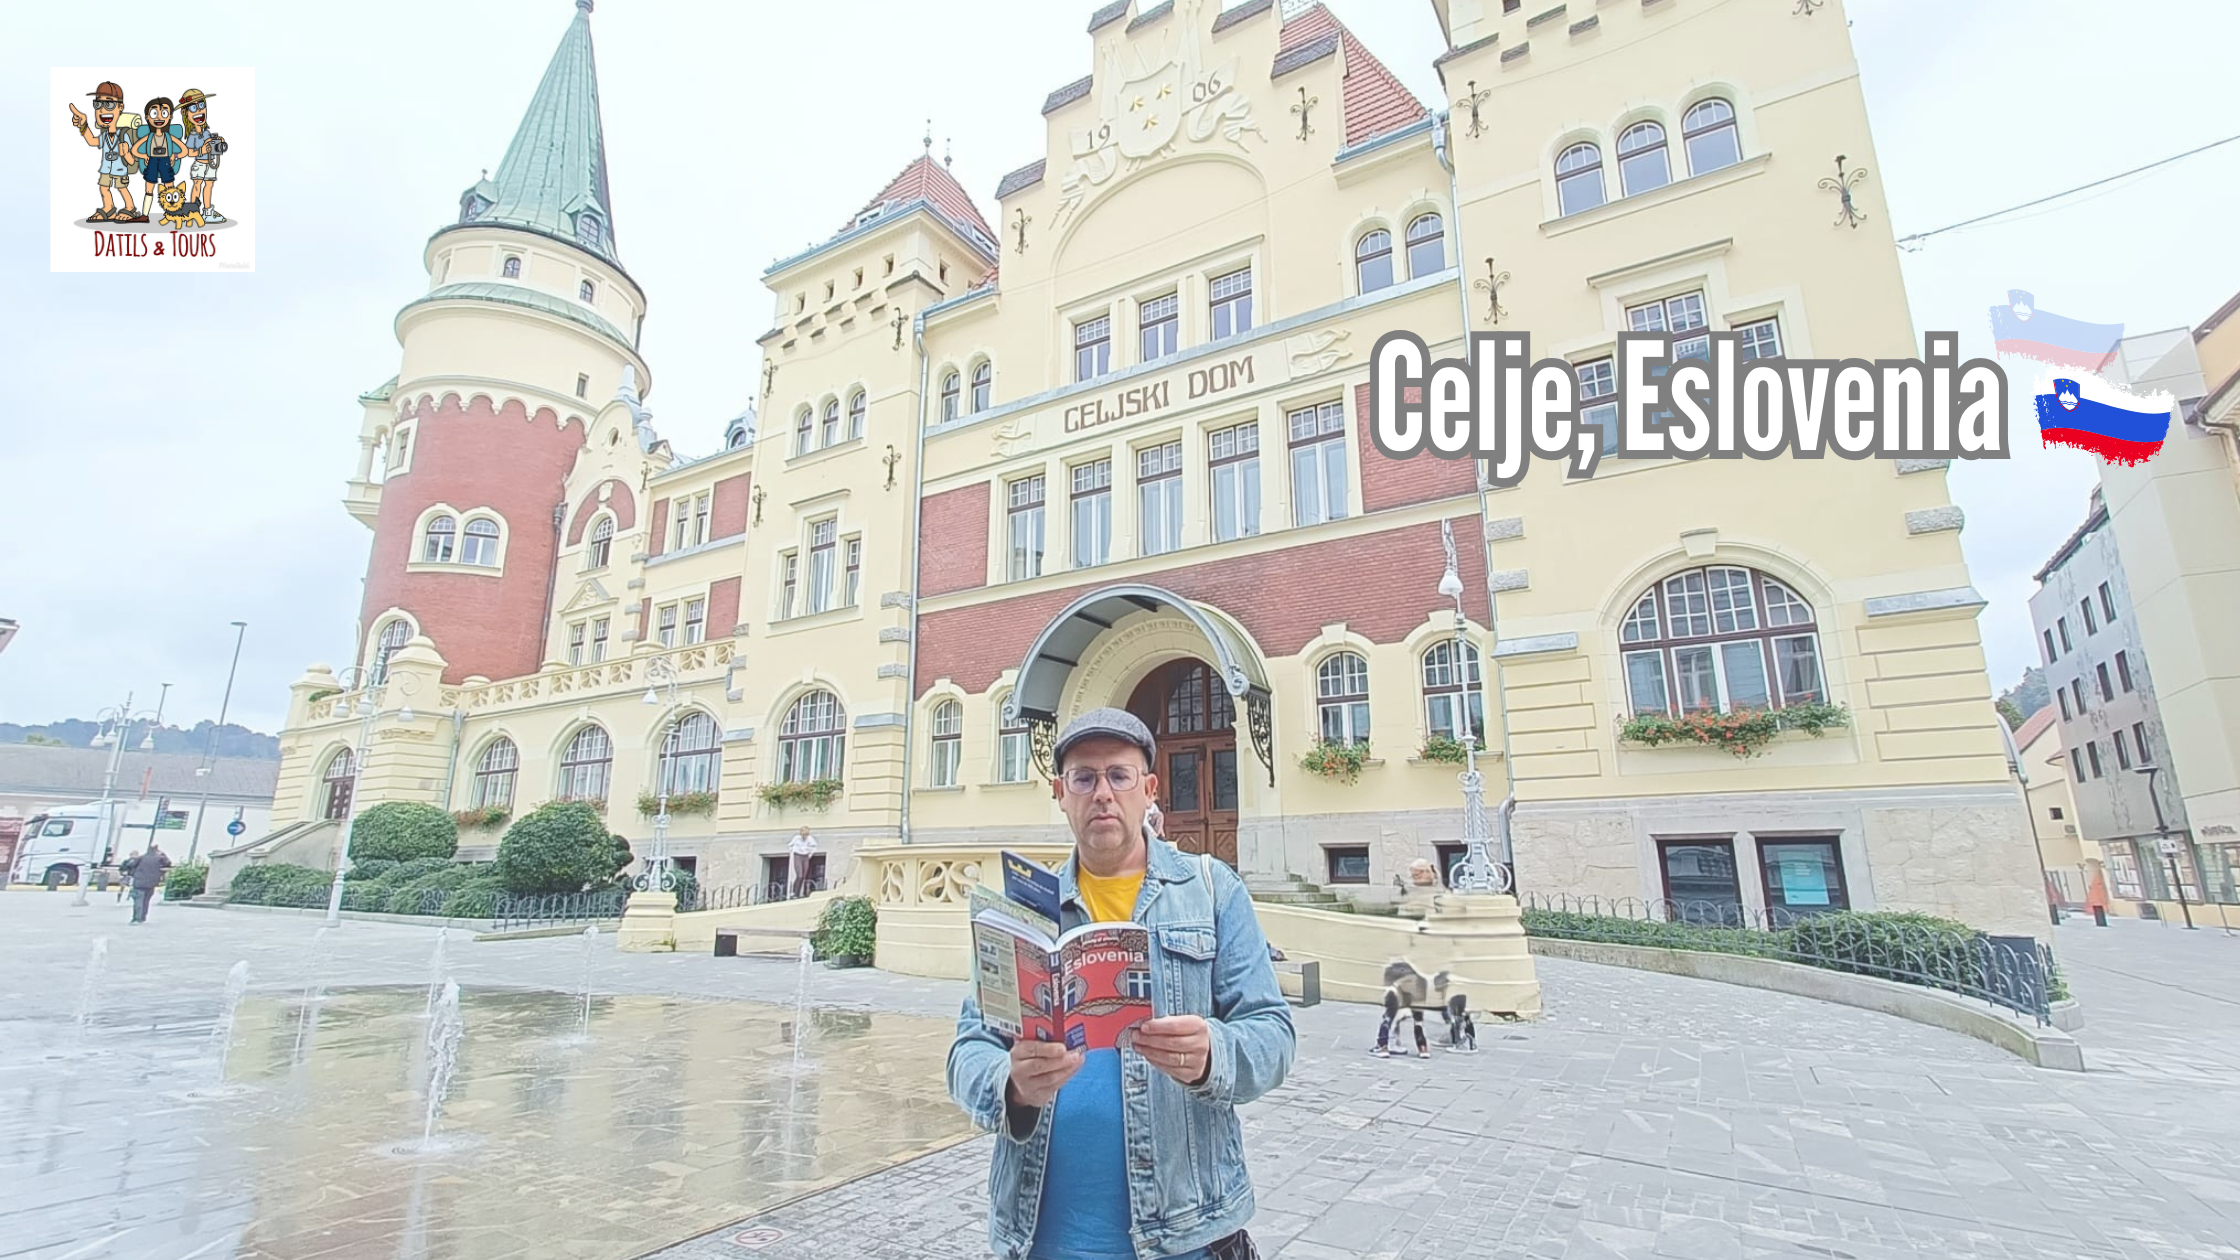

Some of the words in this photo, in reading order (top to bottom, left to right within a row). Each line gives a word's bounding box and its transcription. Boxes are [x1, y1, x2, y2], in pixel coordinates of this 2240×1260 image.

[1087, 124, 1111, 150] 19
[1192, 70, 1221, 103] 06
[1064, 380, 1170, 434] CELJSKI
[1188, 355, 1255, 400] DOM
[1064, 948, 1144, 976] Eslovenia
